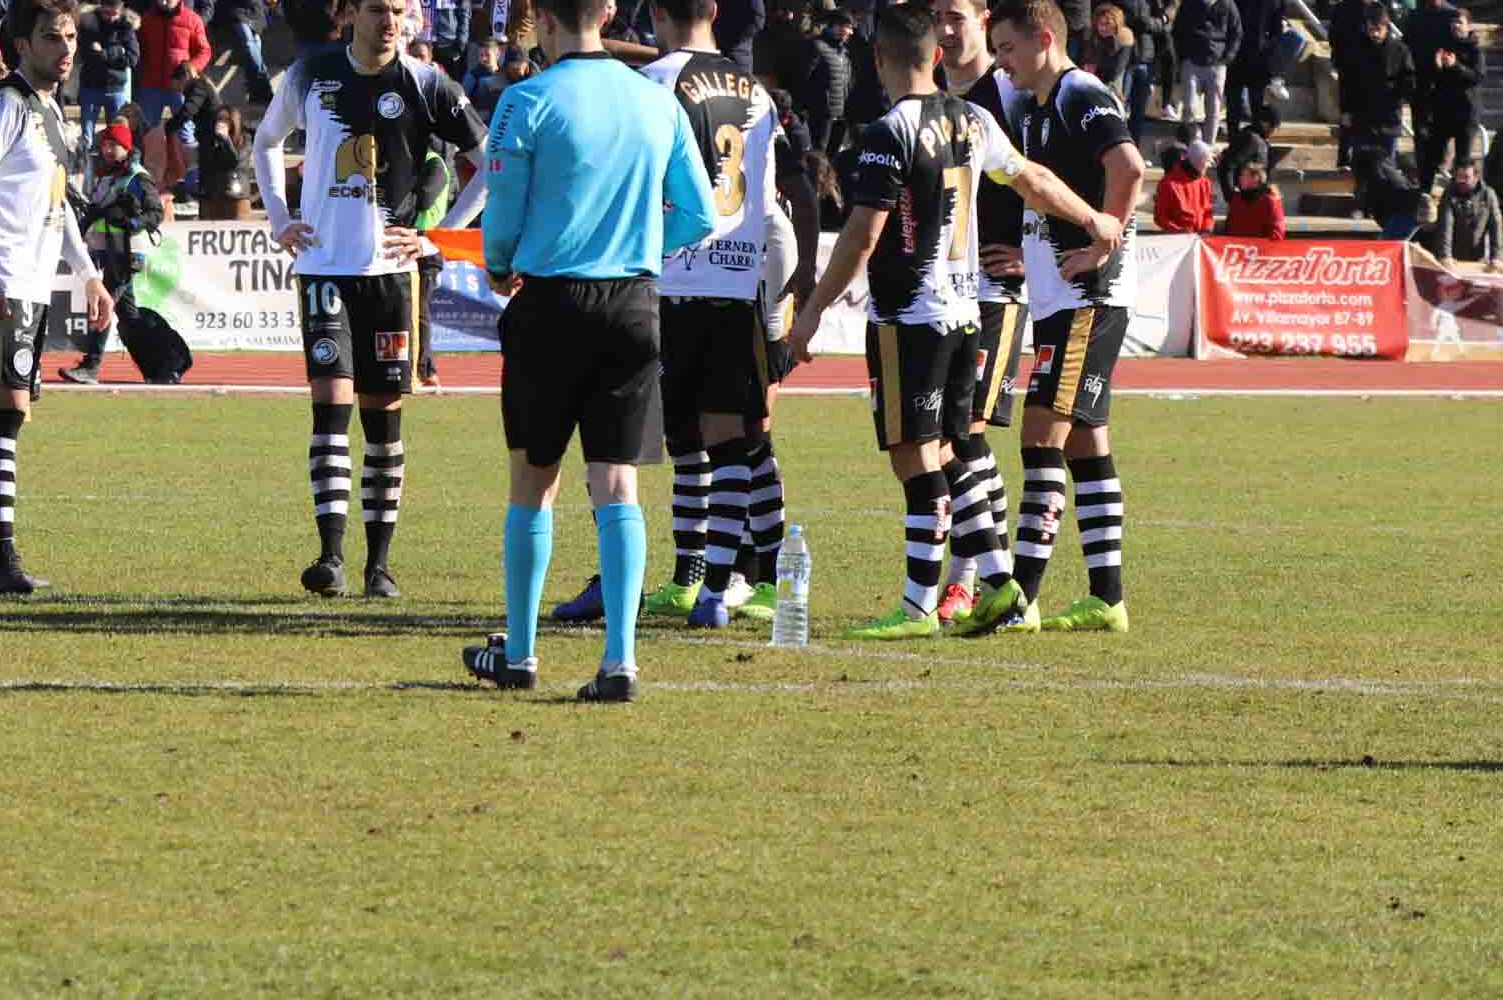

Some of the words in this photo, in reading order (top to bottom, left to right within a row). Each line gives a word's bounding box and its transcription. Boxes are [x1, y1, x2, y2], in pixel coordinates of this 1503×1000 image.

[714, 124, 746, 217] 3
[306, 281, 343, 317] 10
[194, 312, 226, 329] 923
[233, 312, 254, 329] 60
[259, 311, 280, 329] 33
